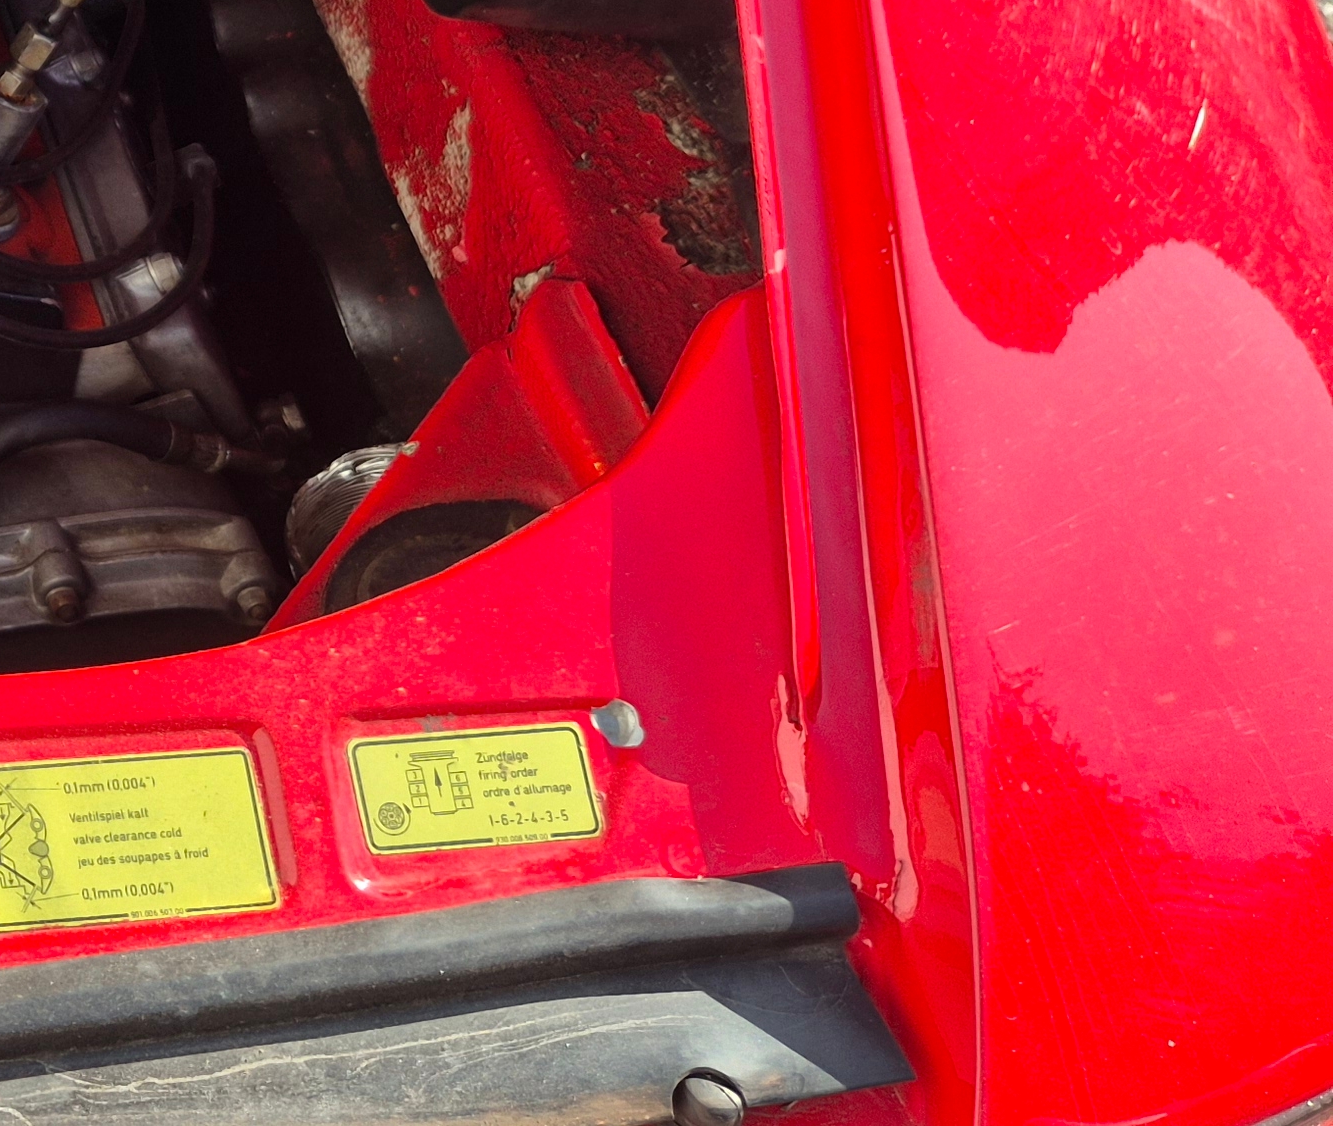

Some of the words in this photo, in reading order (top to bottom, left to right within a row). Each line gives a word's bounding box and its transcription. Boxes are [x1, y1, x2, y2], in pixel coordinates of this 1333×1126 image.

[475, 750, 529, 764] Zündfolge
[478, 768, 508, 782] firing
[510, 767, 538, 779] order
[482, 786, 511, 798] ordre
[514, 782, 572, 797] d'allumage
[69, 808, 125, 824] Ventilspiel
[127, 807, 150, 819] kalt
[488, 809, 569, 827] 1-6-2-4-3-5
[73, 832, 102, 845] valve
[103, 828, 158, 843] clearance
[160, 827, 183, 840] cold
[77, 854, 95, 869] jeu
[97, 853, 116, 866] des
[118, 849, 171, 866] soupapes
[173, 847, 182, 860] à
[184, 846, 209, 859] froid
